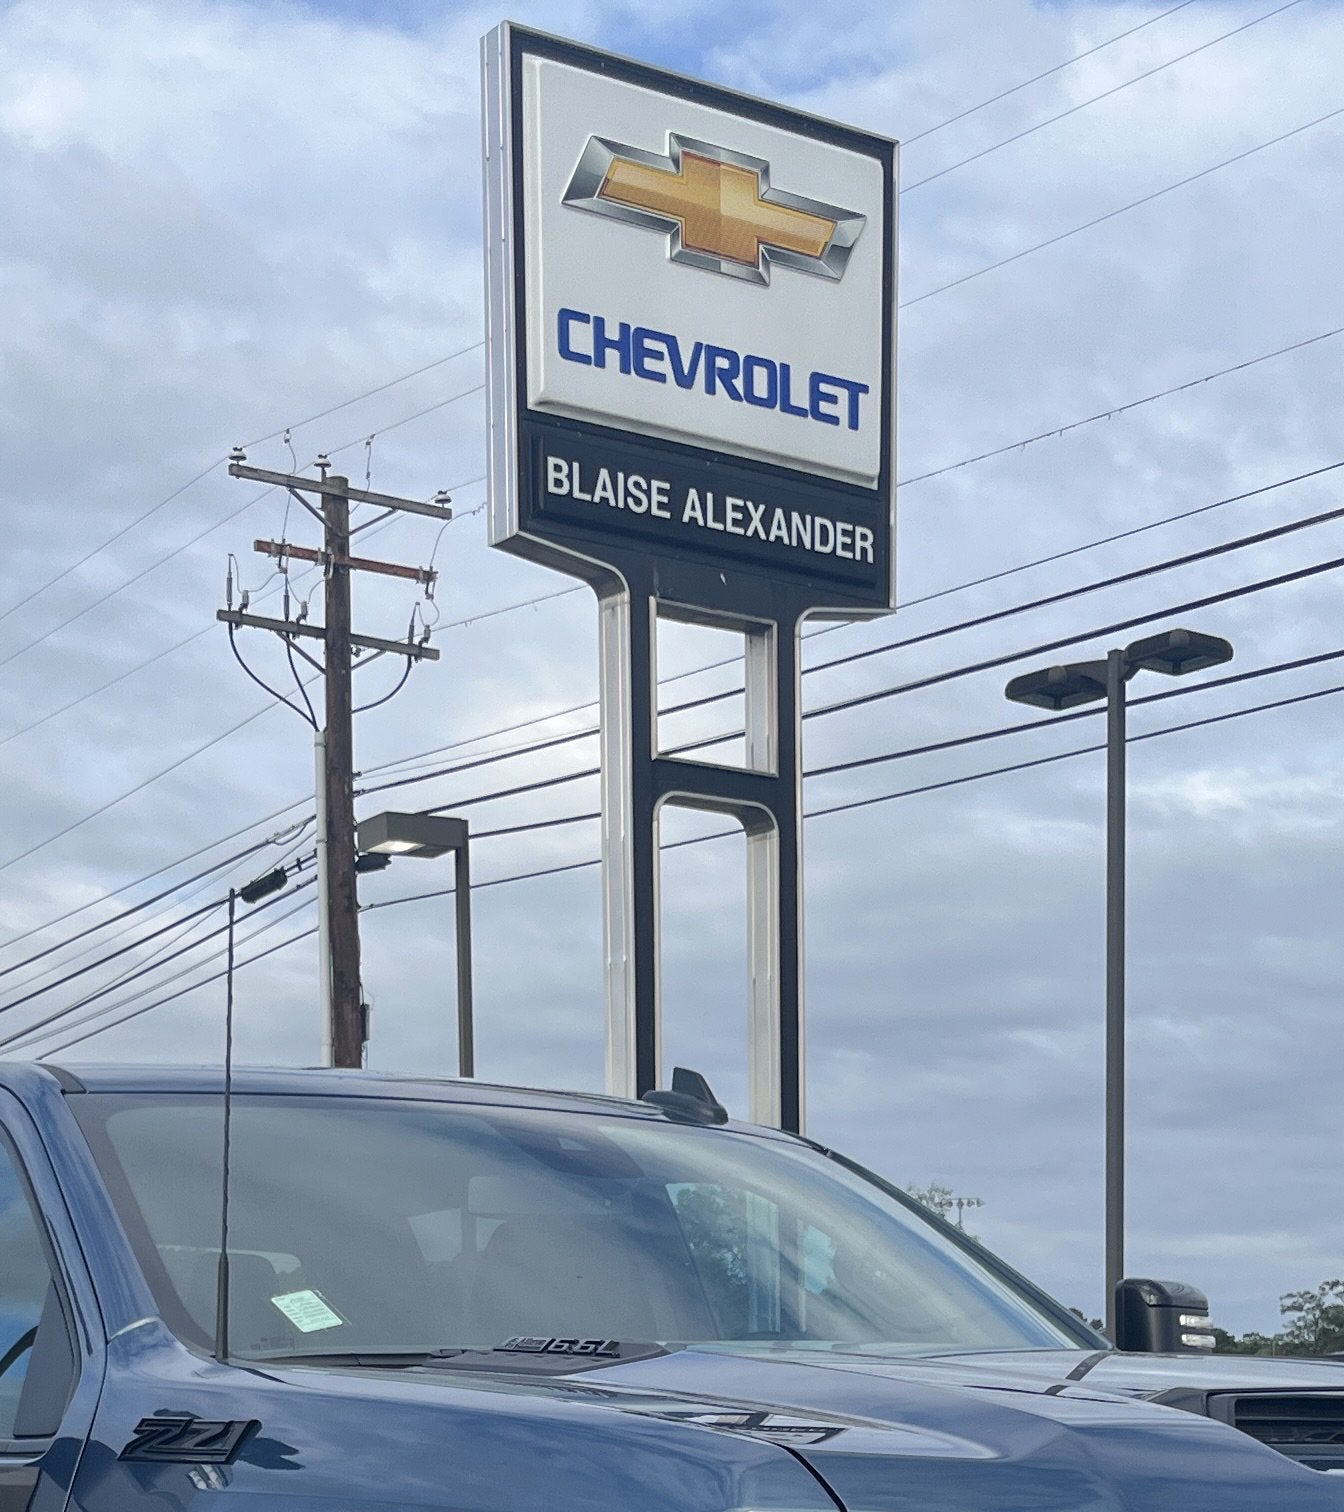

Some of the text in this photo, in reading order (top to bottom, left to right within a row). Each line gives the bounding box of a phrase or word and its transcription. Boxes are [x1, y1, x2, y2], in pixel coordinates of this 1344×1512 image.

[557, 307, 870, 431] CHEVROLET
[546, 455, 875, 564] BLAISE ALEXANDER
